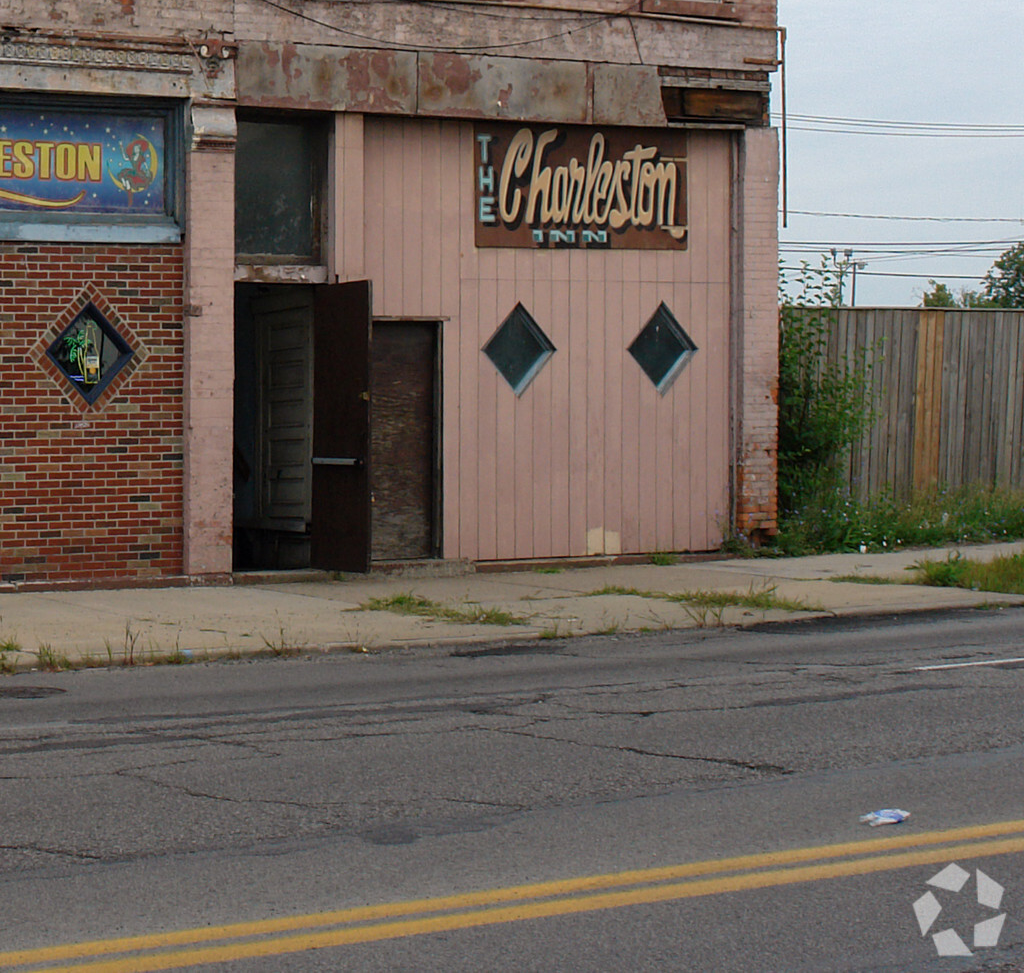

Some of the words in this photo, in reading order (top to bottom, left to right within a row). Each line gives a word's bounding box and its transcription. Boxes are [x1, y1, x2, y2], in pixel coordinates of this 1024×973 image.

[478, 133, 496, 223] THE
[499, 128, 684, 239] Charleston
[533, 229, 607, 243] INN
